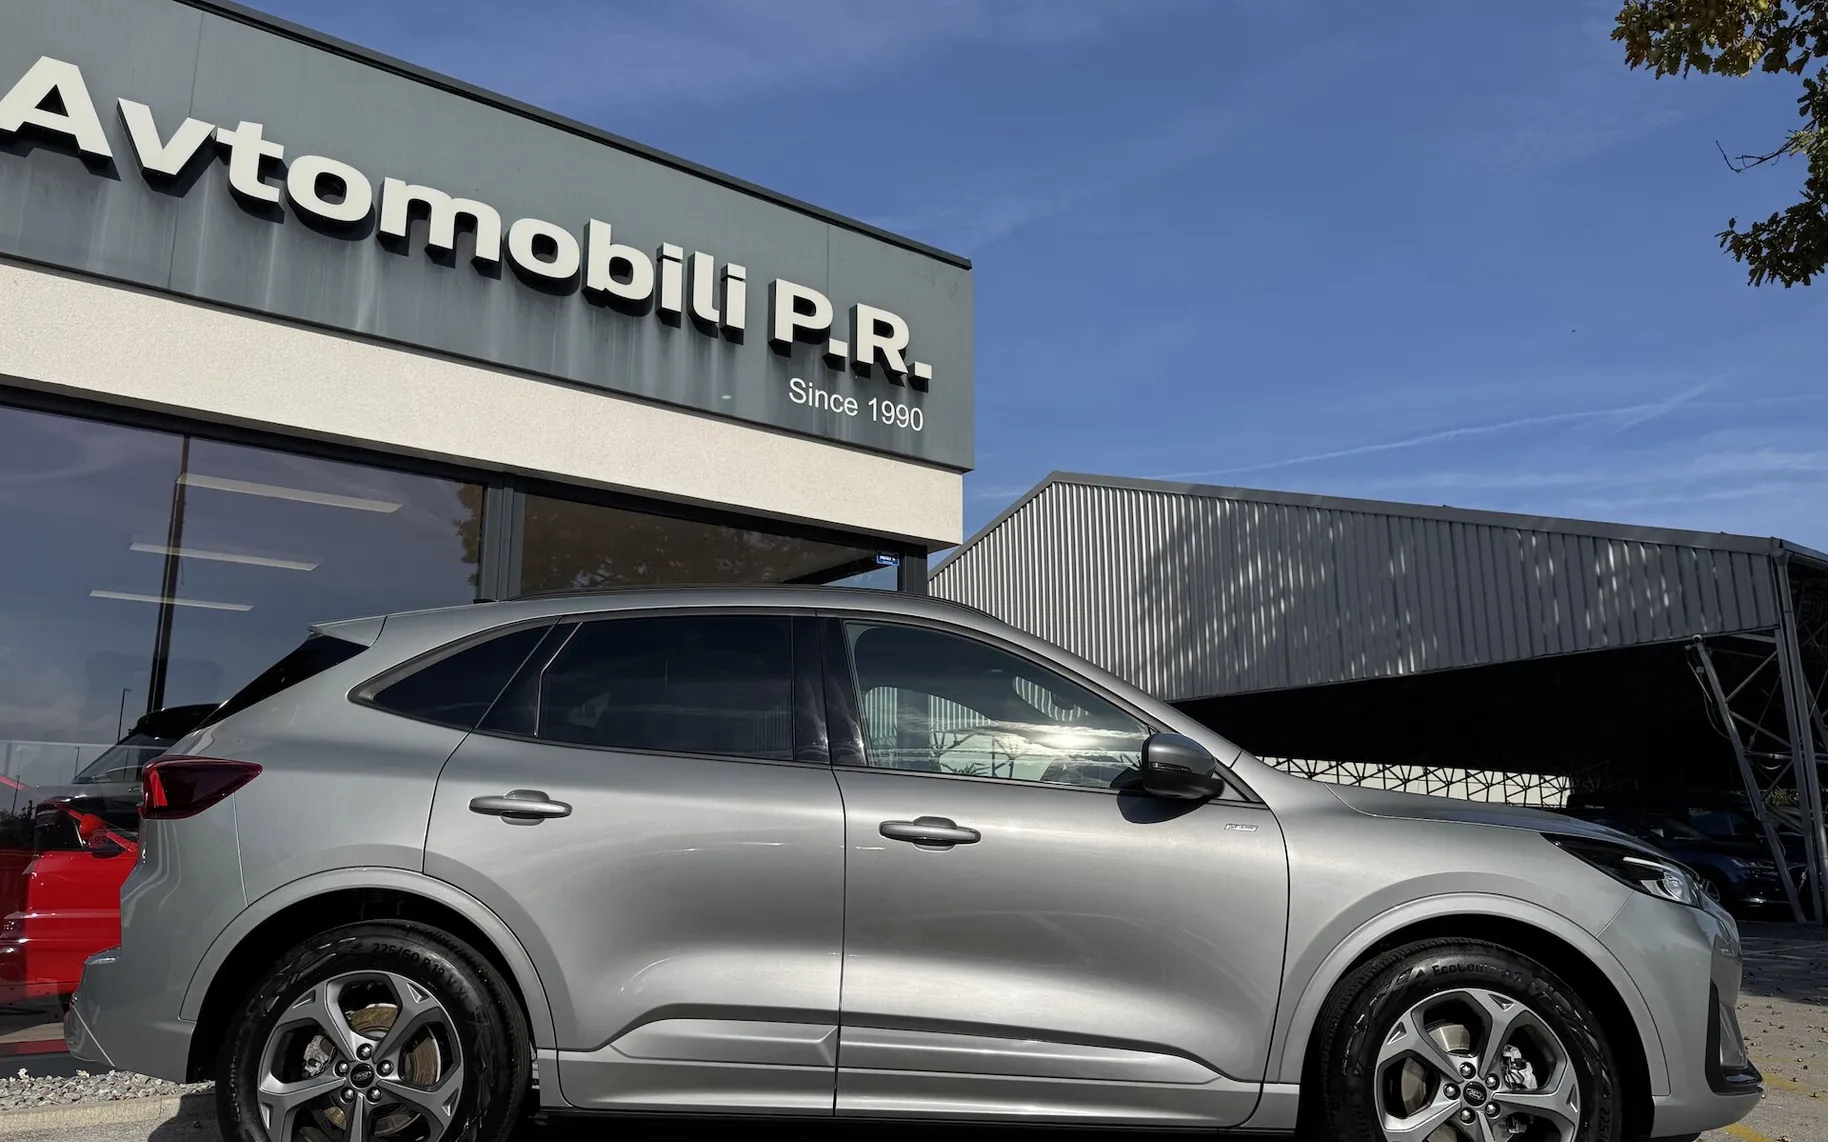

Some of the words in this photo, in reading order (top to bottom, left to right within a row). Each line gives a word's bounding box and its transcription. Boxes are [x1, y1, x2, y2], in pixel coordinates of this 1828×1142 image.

[0, 56, 746, 331] Avtomobili
[772, 278, 932, 380] P.R.
[789, 377, 858, 417] Since
[868, 397, 923, 431] 1990
